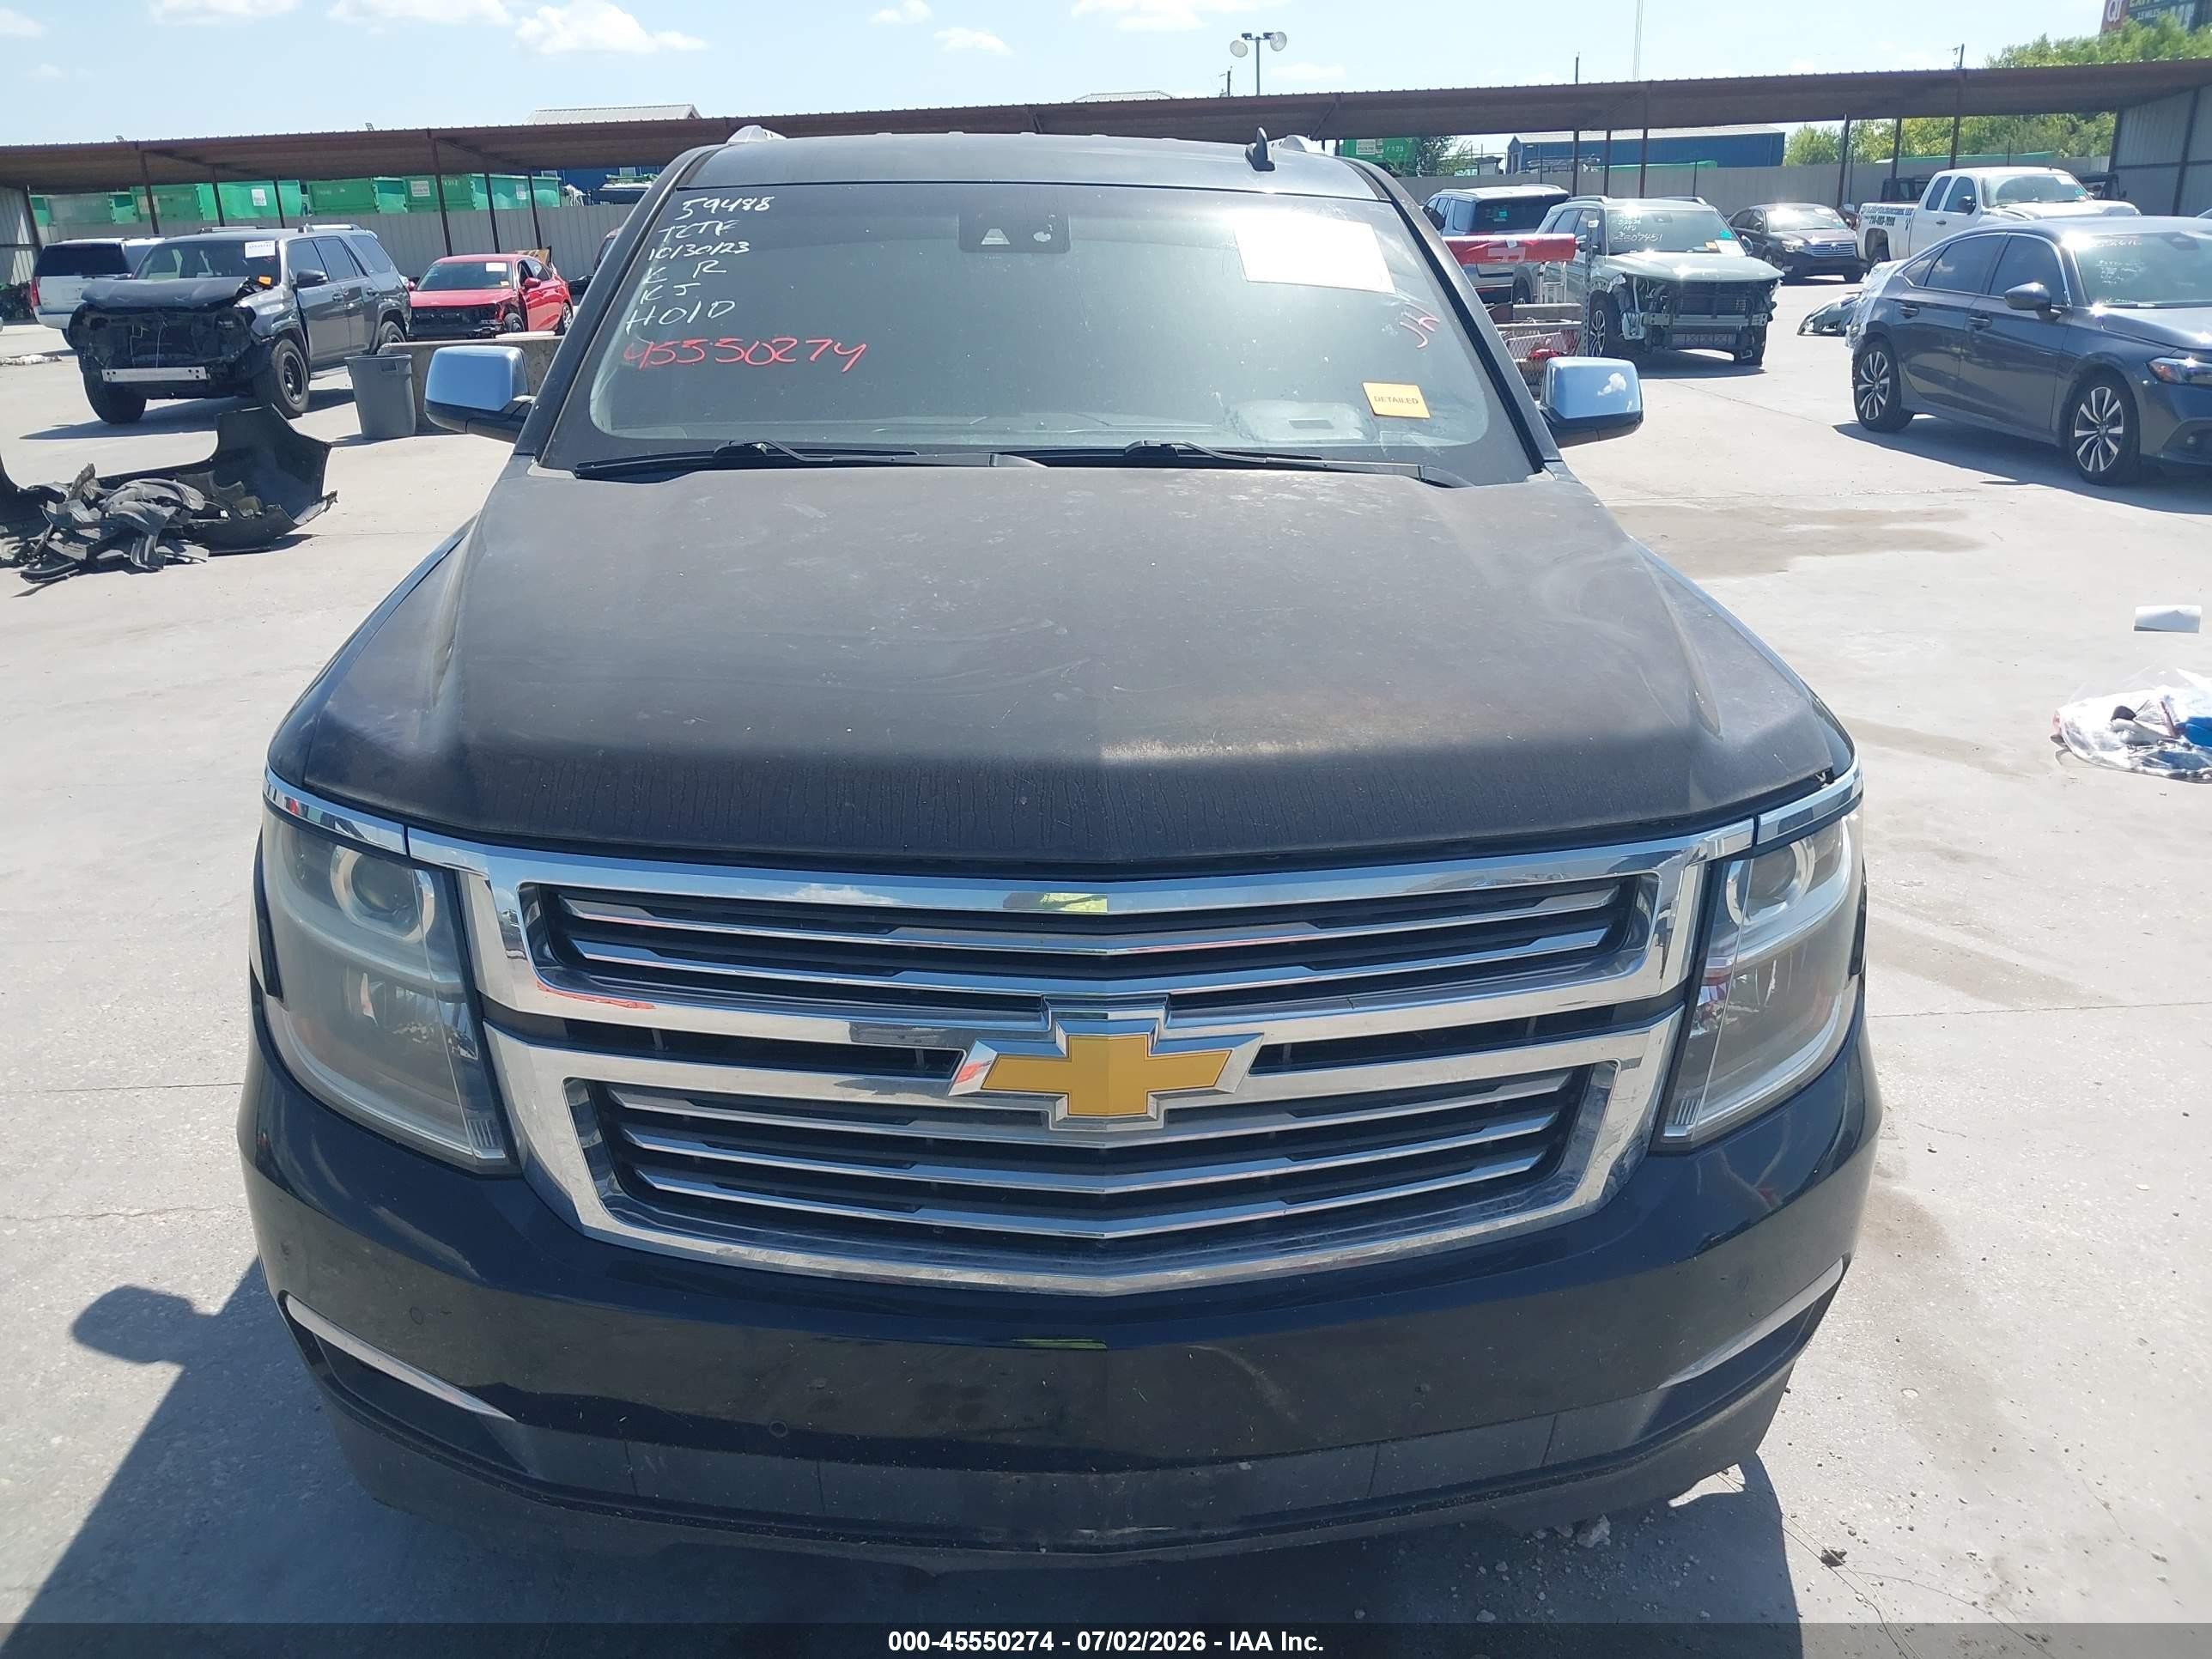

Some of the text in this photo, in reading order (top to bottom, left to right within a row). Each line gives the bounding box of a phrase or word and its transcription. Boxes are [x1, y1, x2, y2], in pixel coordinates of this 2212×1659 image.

[648, 241, 750, 261] 10/30/23
[623, 337, 867, 373] 45550274
[1373, 395, 1419, 404] DETAILED
